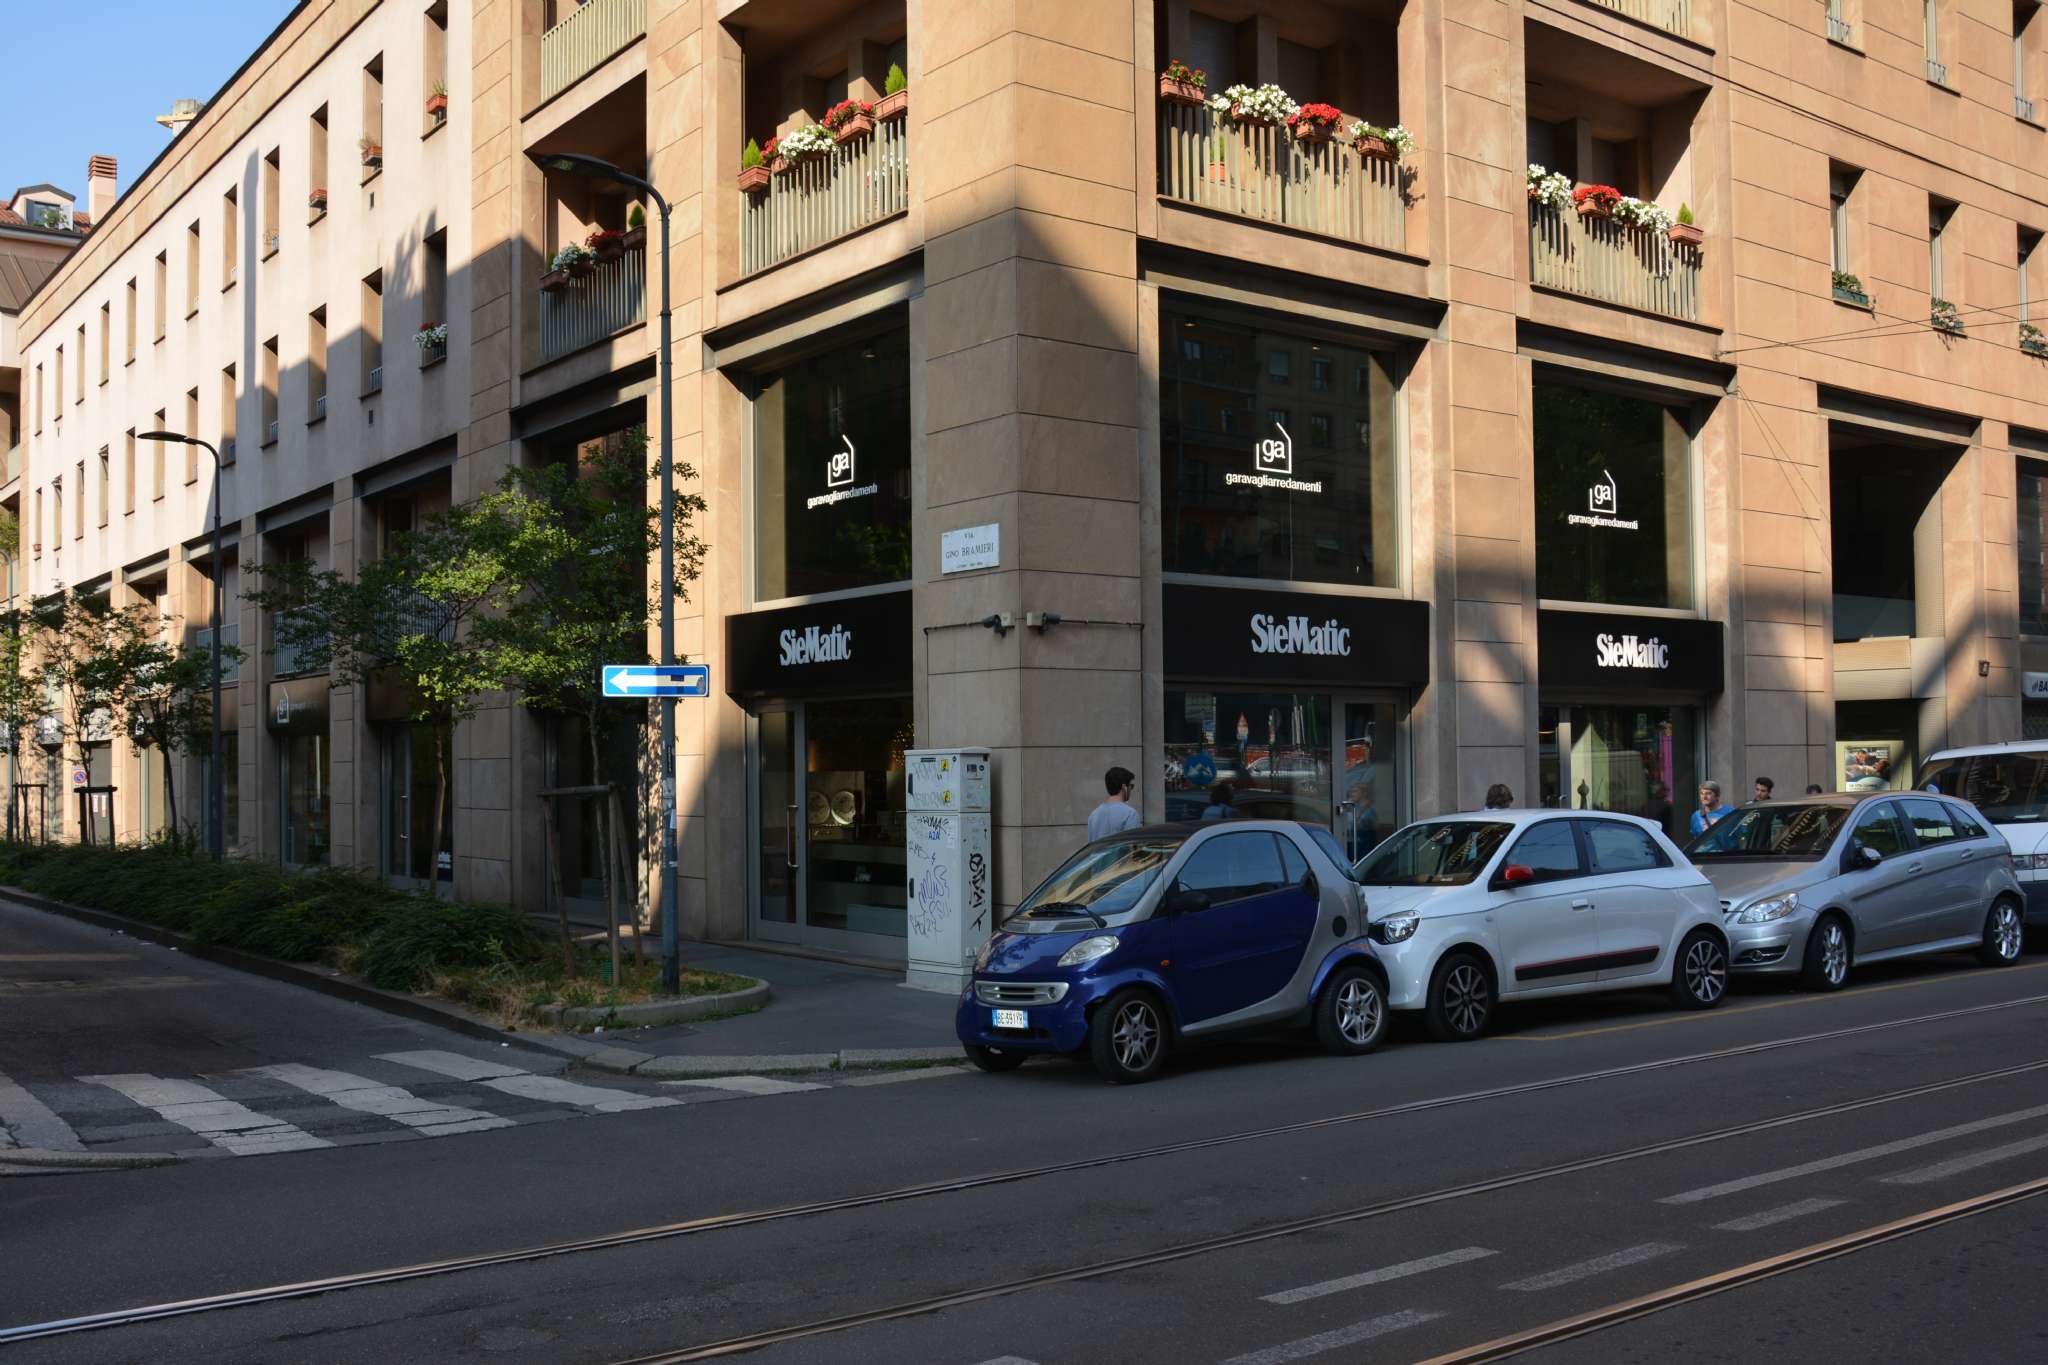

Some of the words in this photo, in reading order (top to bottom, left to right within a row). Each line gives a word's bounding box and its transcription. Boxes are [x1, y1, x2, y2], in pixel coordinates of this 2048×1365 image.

[1262, 439, 1286, 463] ga
[832, 452, 850, 477] ga
[1225, 473, 1322, 493] garavagliarredamenti
[1594, 484, 1612, 505] ga
[1568, 514, 1639, 530] garavagliarredamenti
[945, 550, 959, 559] GINO
[780, 624, 851, 666] SieMatic
[1250, 613, 1351, 656] SieMatic
[1597, 633, 1669, 669] SieMatic
